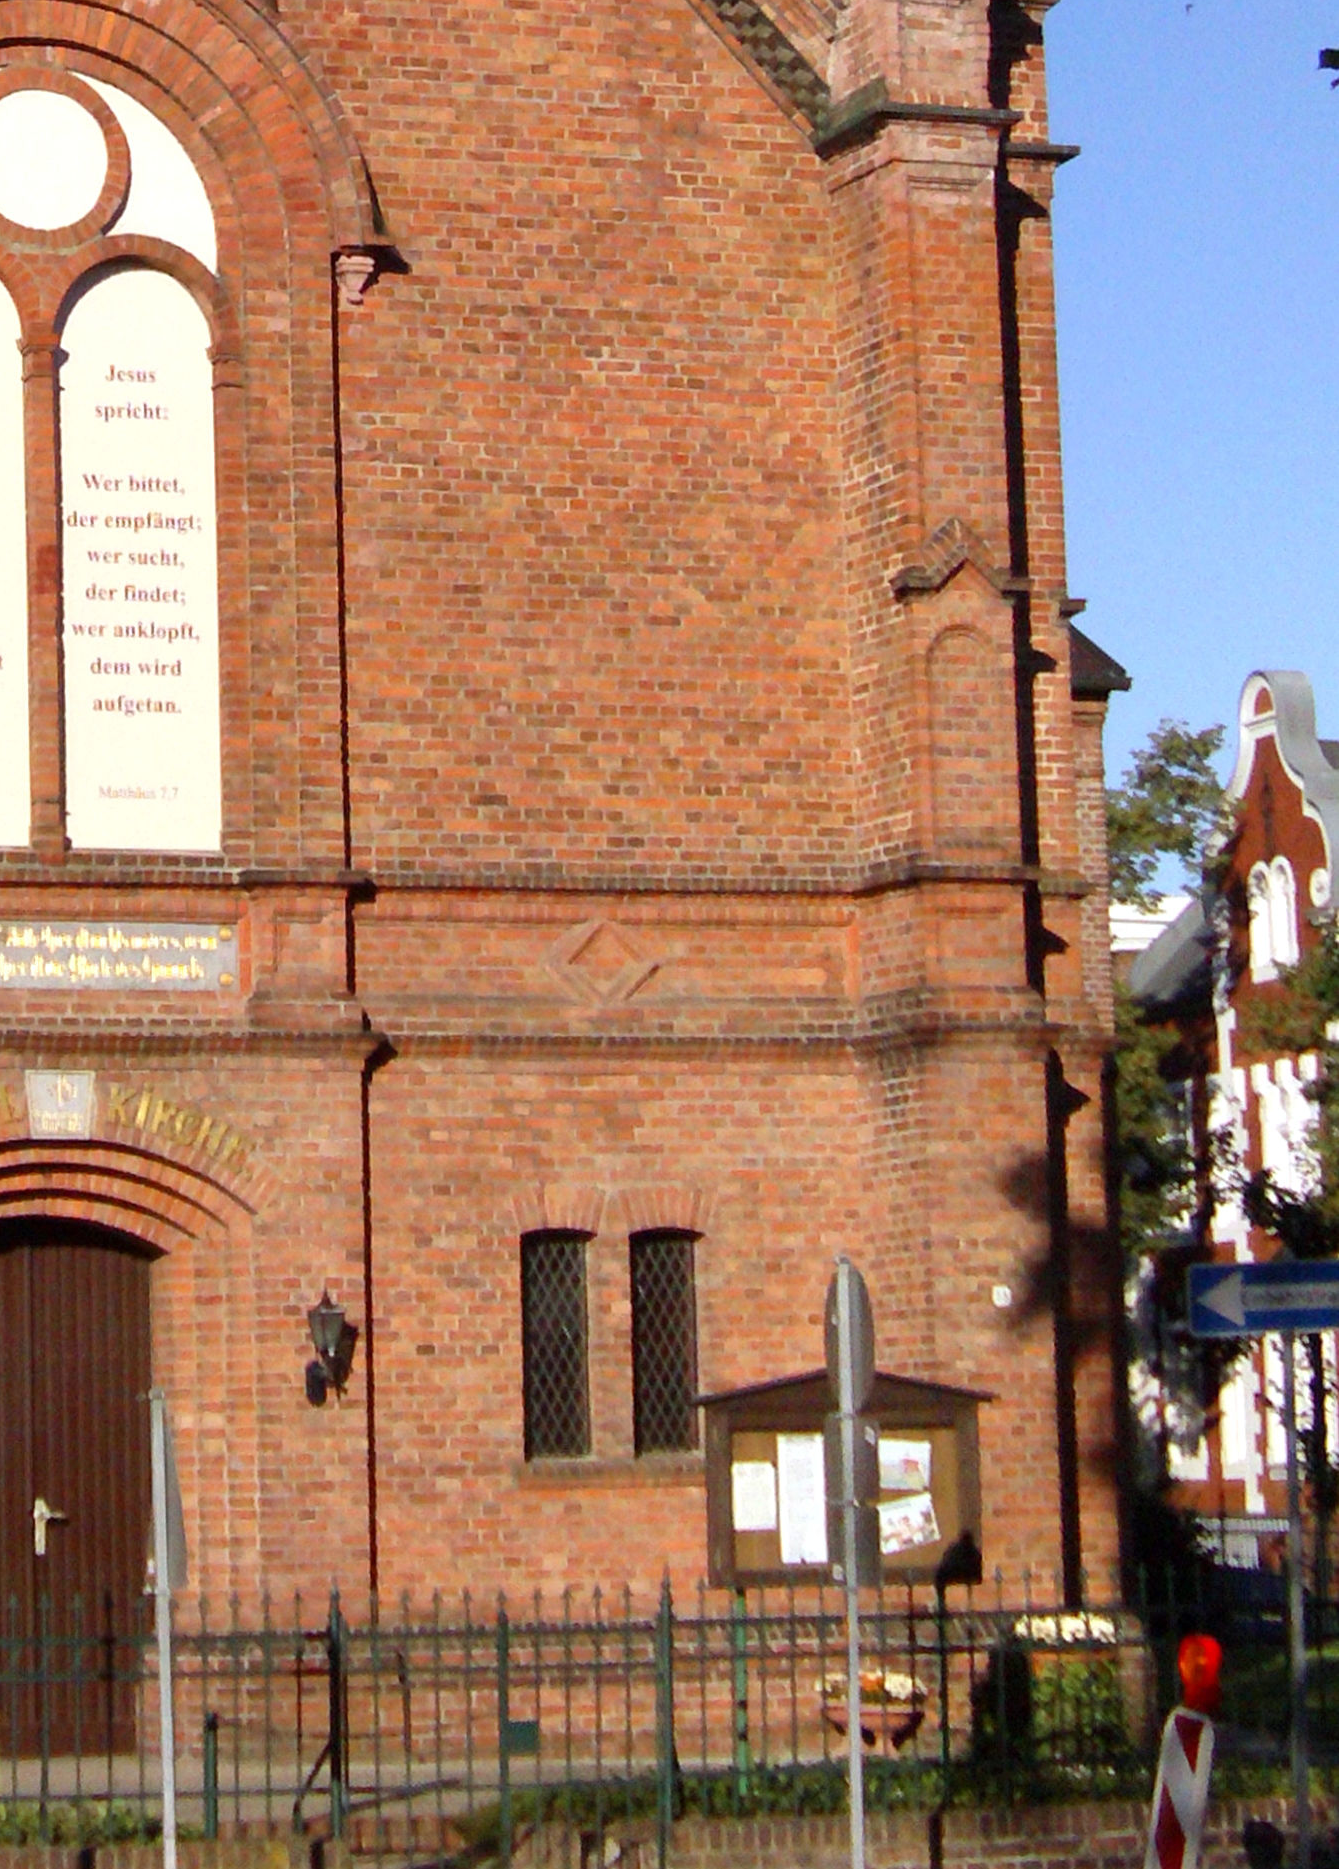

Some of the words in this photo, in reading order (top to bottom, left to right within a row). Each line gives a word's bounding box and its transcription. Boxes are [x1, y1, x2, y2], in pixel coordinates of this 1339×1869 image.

[105, 364, 156, 383] Jesus
[95, 403, 168, 423] spricht:
[82, 474, 123, 492] Wer
[129, 476, 185, 494] bittet,
[66, 510, 98, 528] der
[104, 511, 202, 534] empfängt;
[87, 551, 123, 564] wer
[128, 549, 185, 568] sucht,
[85, 583, 118, 601] der
[124, 584, 185, 606] findet;
[72, 624, 106, 637] wer
[113, 621, 200, 644] anklopft,
[90, 657, 130, 675] dem
[138, 659, 181, 676] wird
[93, 695, 182, 716] aufgetan.
